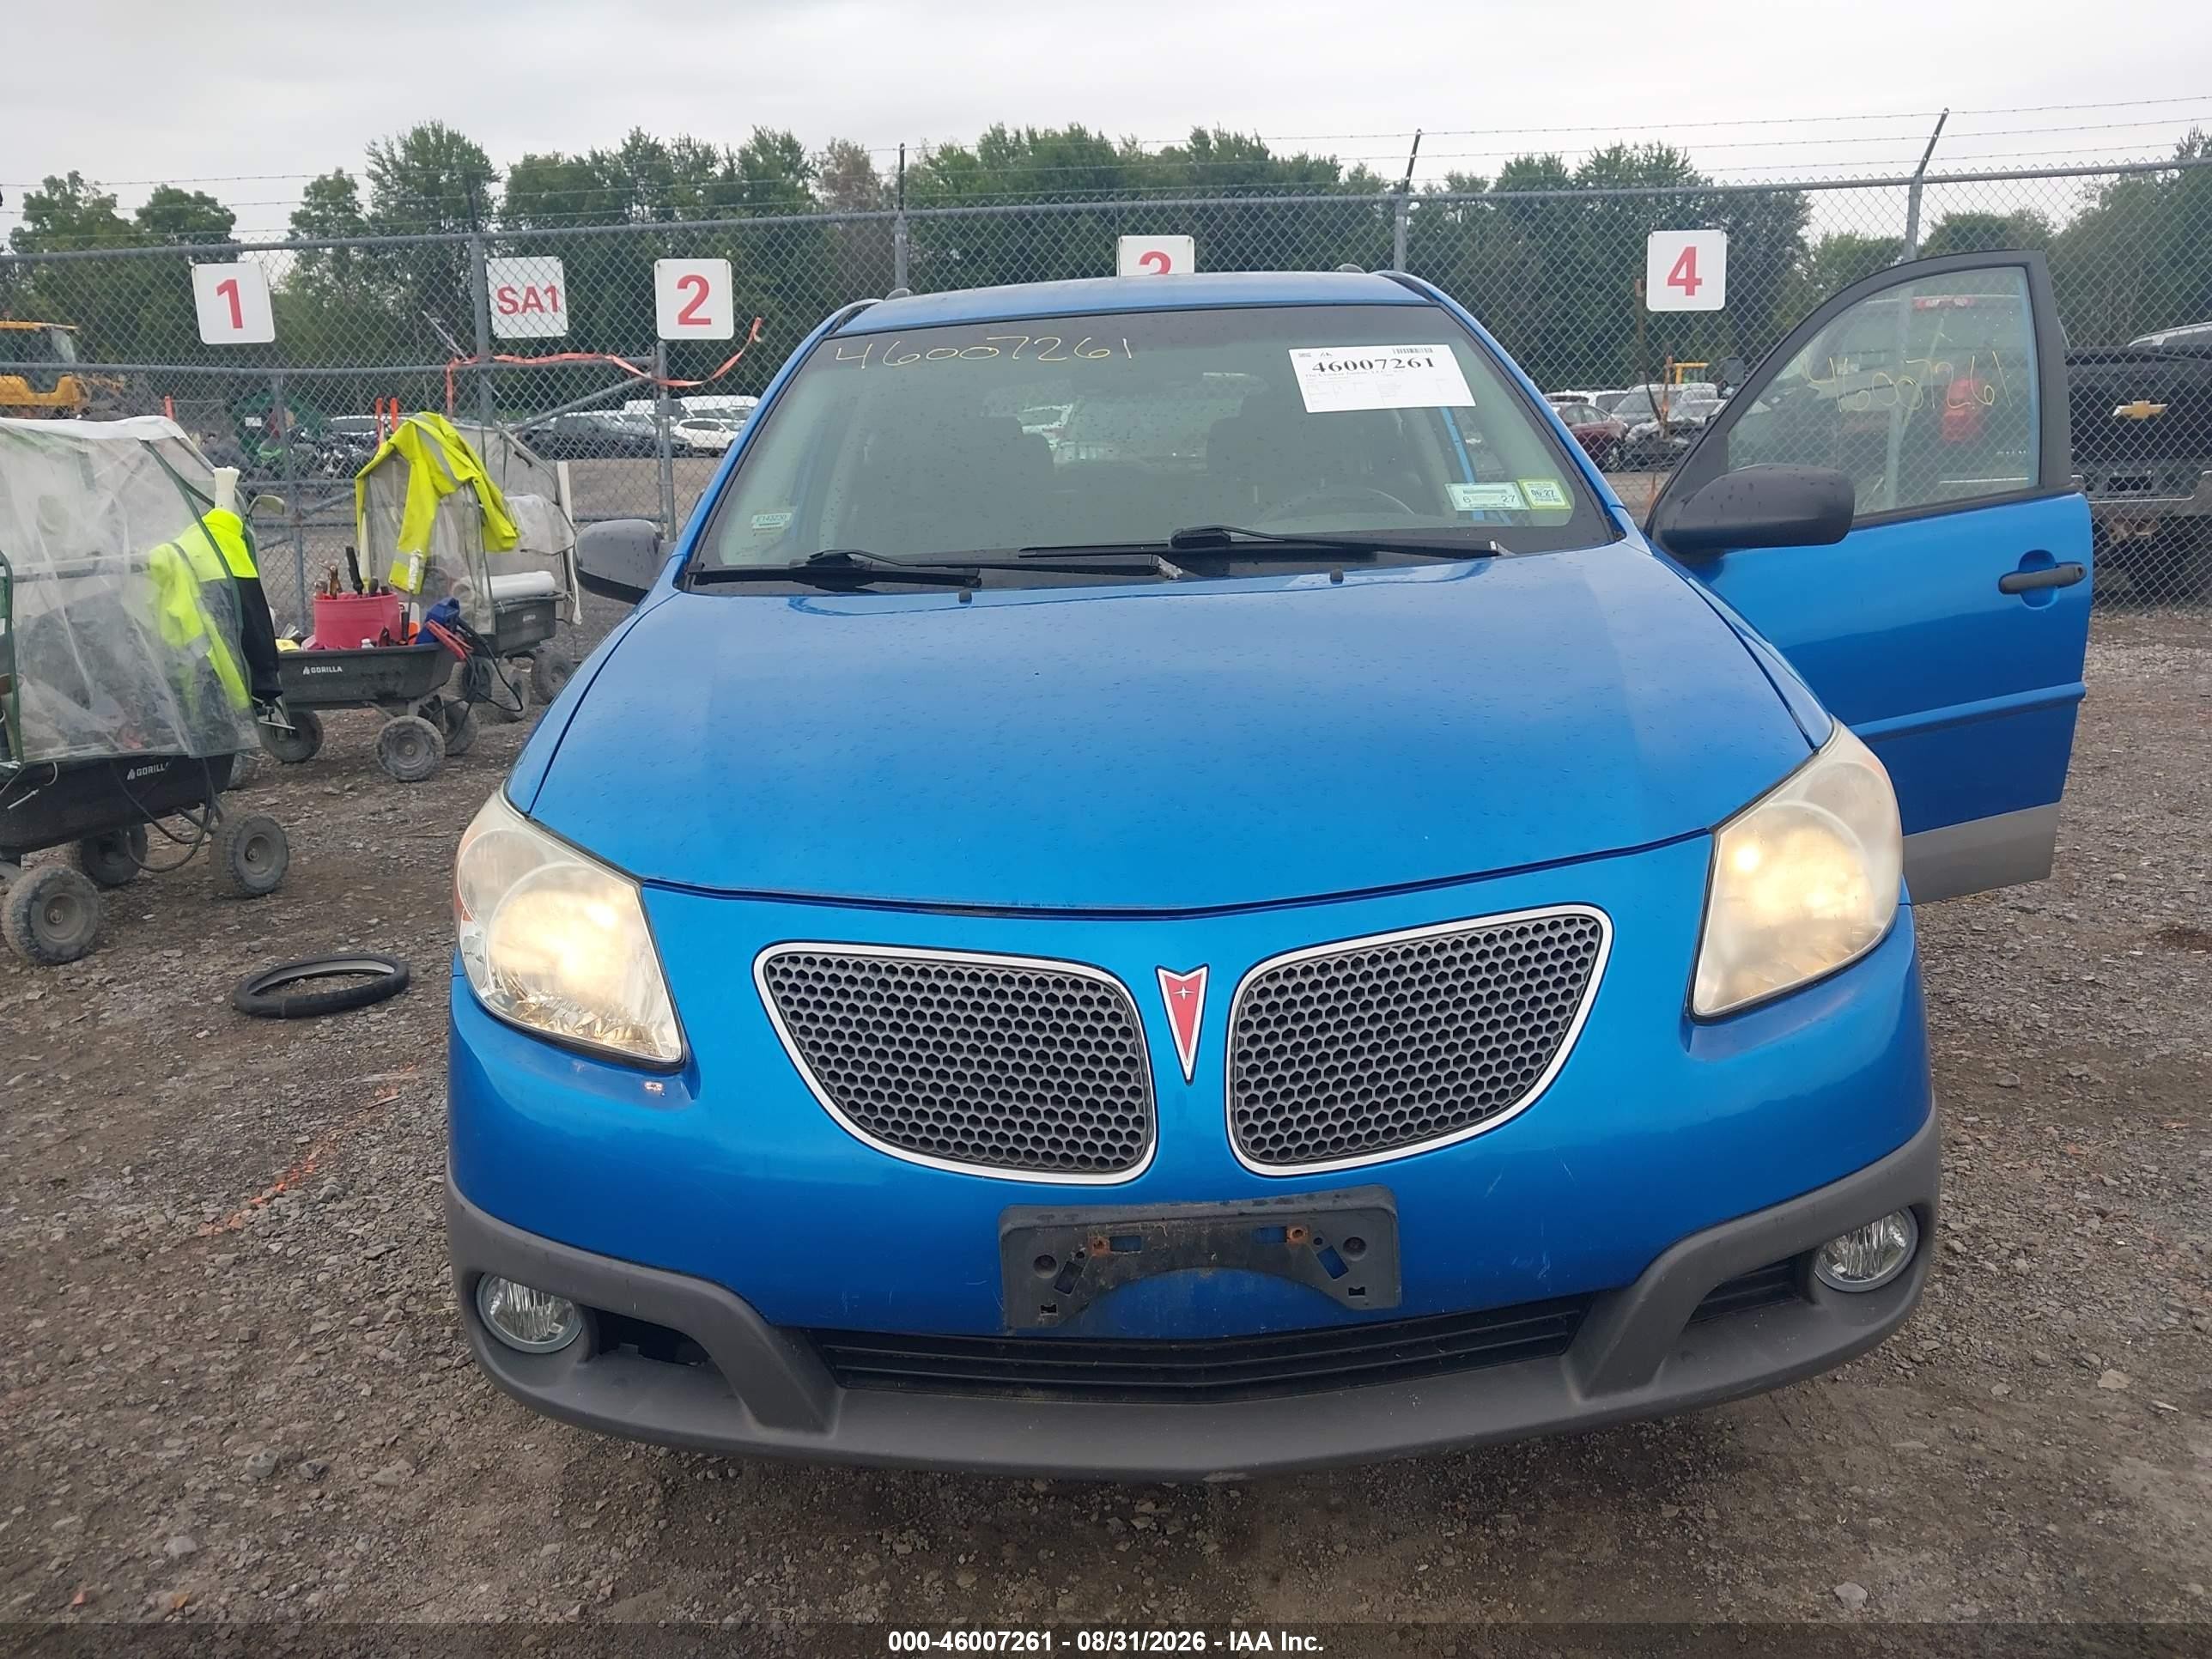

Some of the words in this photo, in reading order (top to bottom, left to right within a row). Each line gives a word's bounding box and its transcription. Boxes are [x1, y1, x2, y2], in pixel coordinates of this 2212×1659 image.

[1667, 246, 1703, 296] 4
[215, 278, 244, 330] 1
[496, 285, 560, 315] SA1
[677, 274, 713, 325] 2
[836, 336, 1133, 370] 46007261
[1311, 356, 1437, 374] 46007261
[1805, 349, 2013, 413] 46007261
[310, 665, 343, 674] GORILLA
